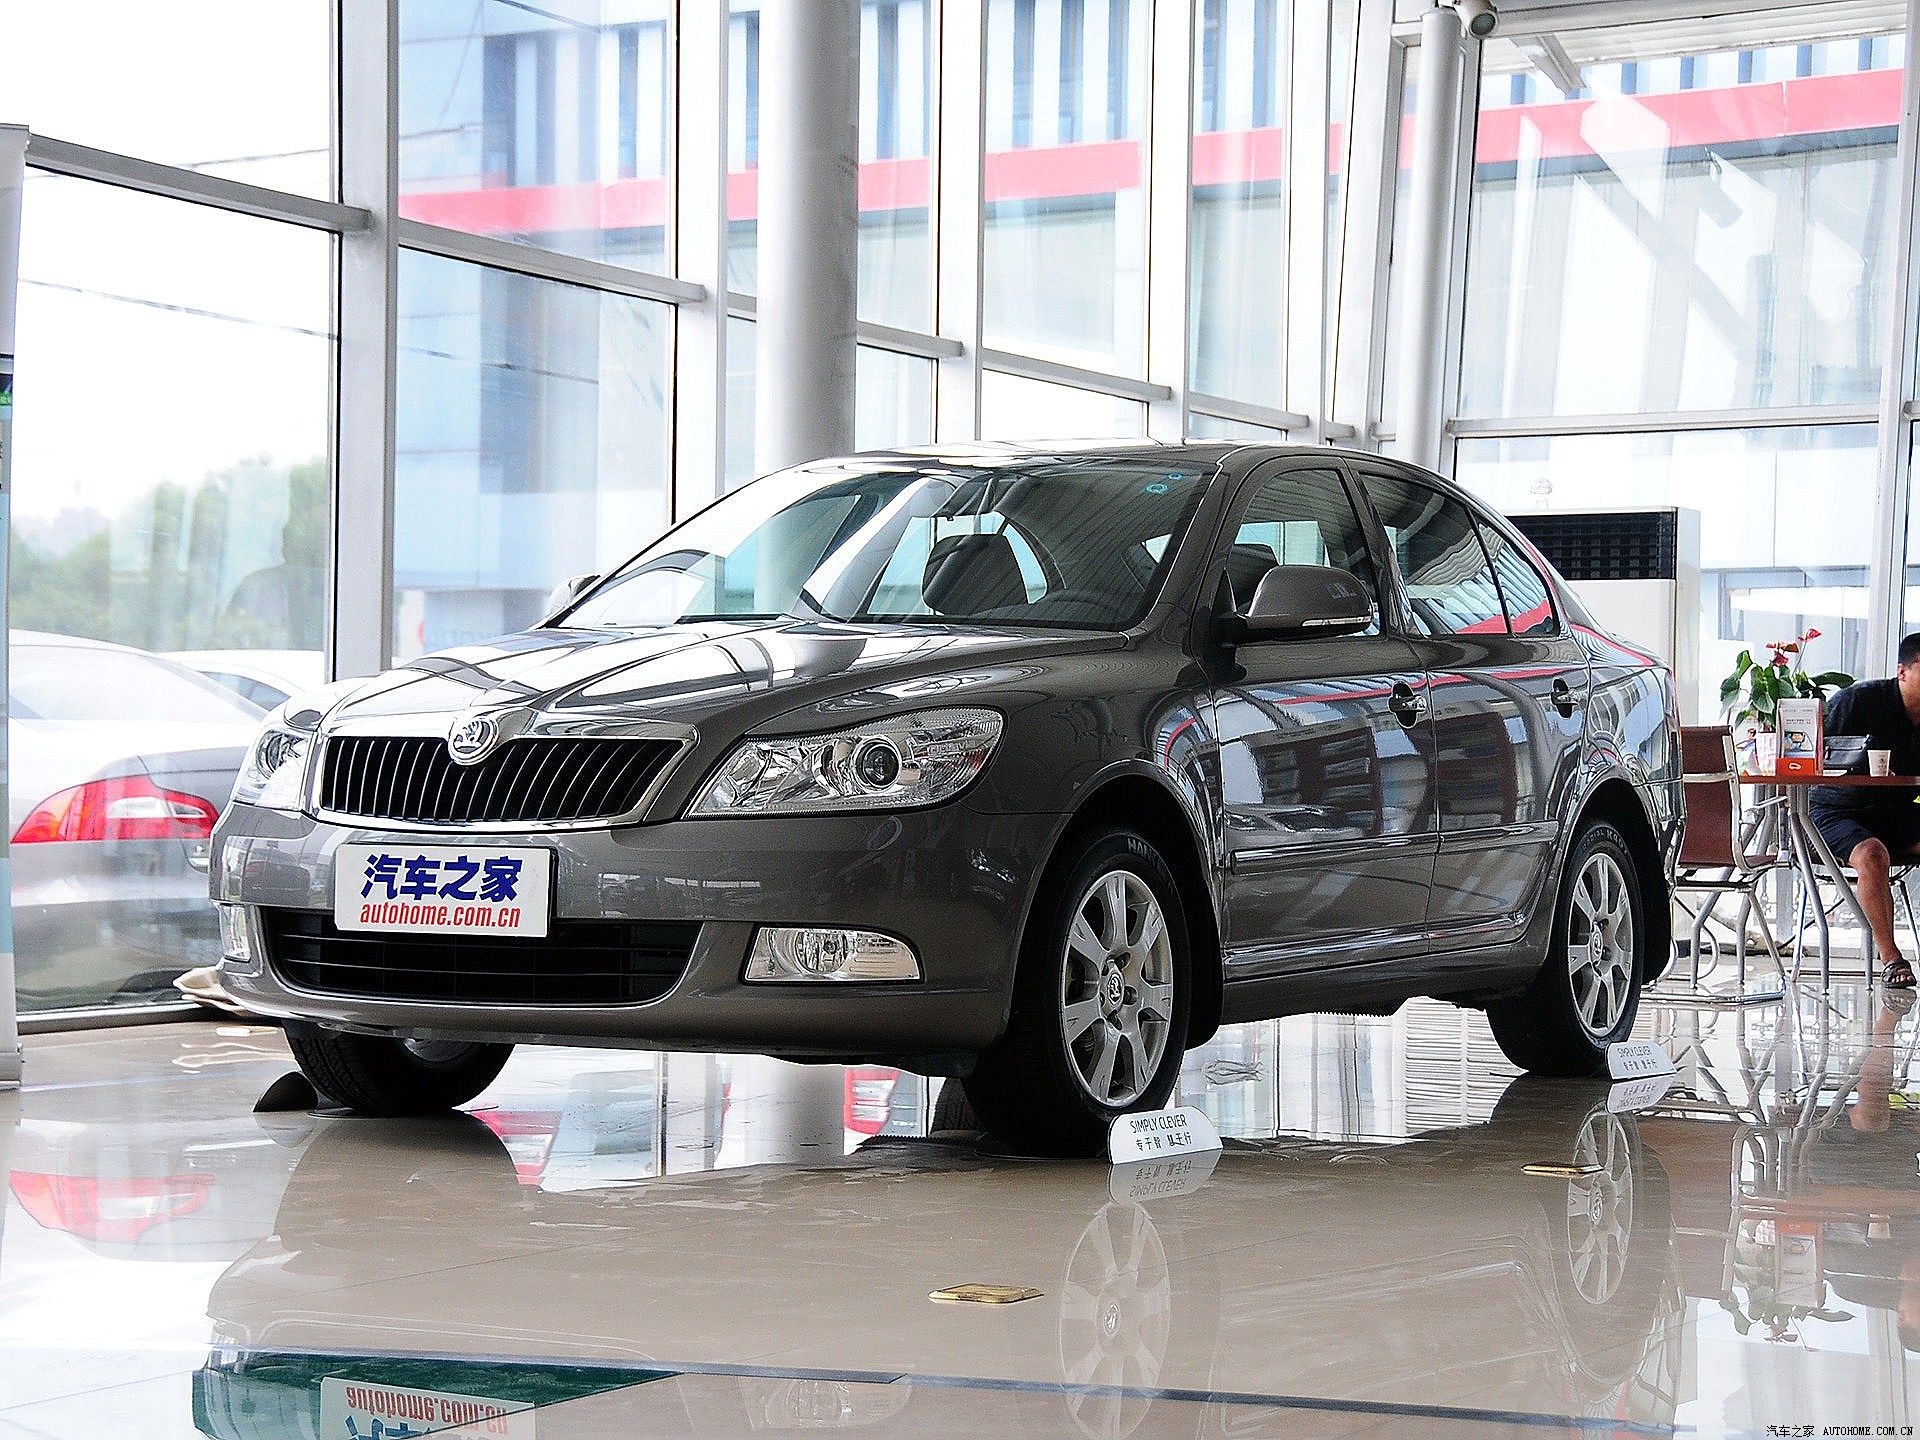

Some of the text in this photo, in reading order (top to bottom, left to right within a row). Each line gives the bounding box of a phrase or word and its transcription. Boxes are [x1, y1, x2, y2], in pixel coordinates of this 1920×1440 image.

[361, 854, 522, 902] 汽车之家
[360, 901, 521, 927] autohome.com.cn
[1130, 1114, 1187, 1133] SIMPLY CLEVER
